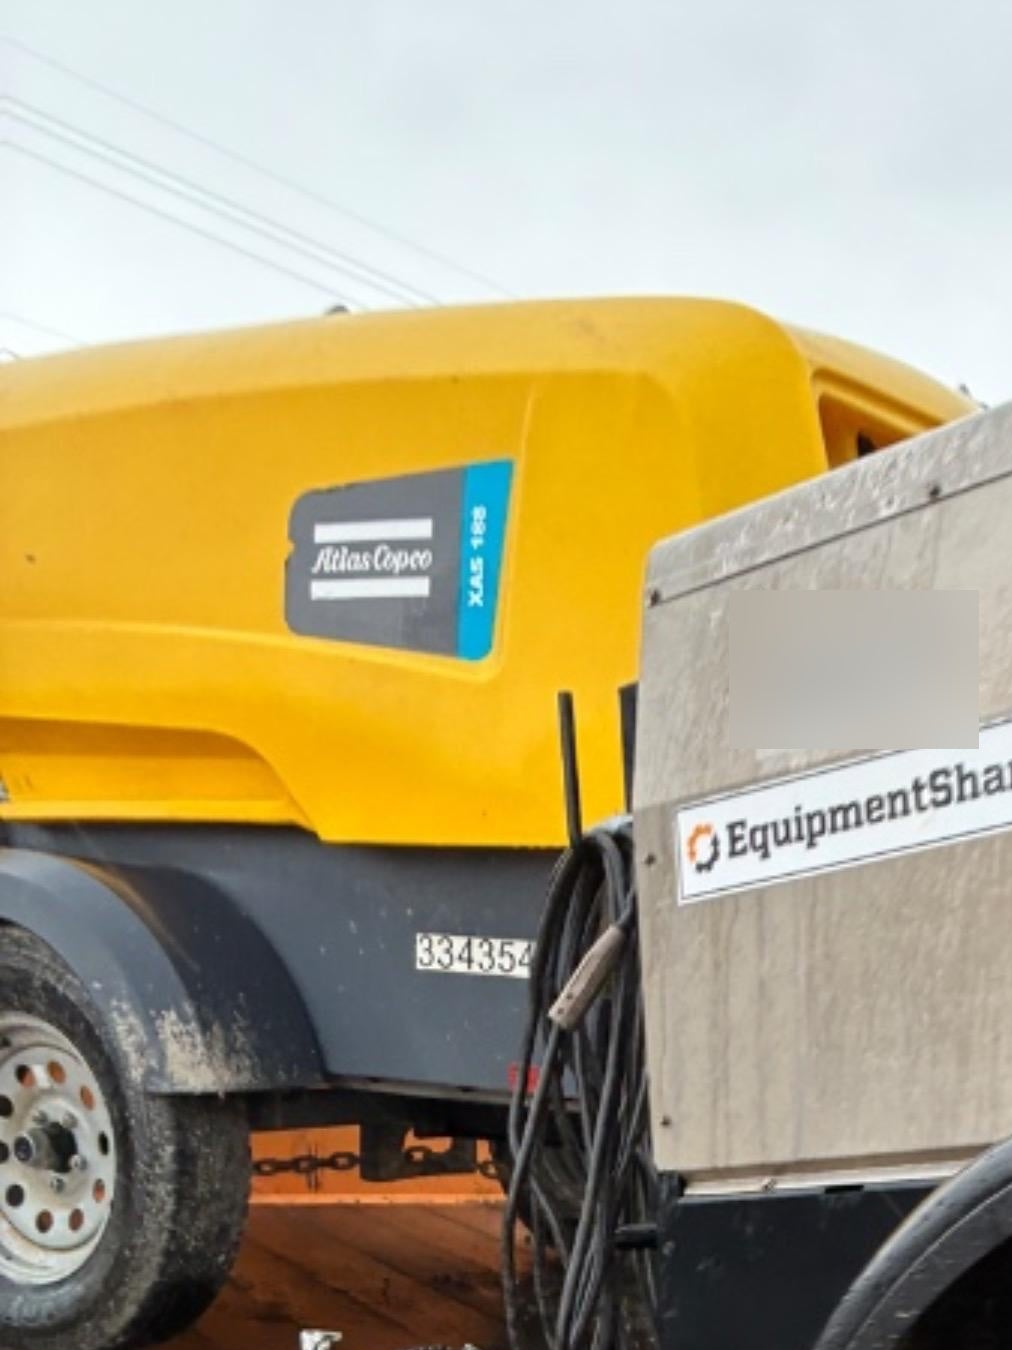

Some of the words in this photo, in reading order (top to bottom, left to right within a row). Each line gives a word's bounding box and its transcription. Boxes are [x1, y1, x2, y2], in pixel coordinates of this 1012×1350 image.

[312, 546, 370, 573] Atlas
[373, 544, 432, 575] Copco
[468, 558, 484, 607] XAS
